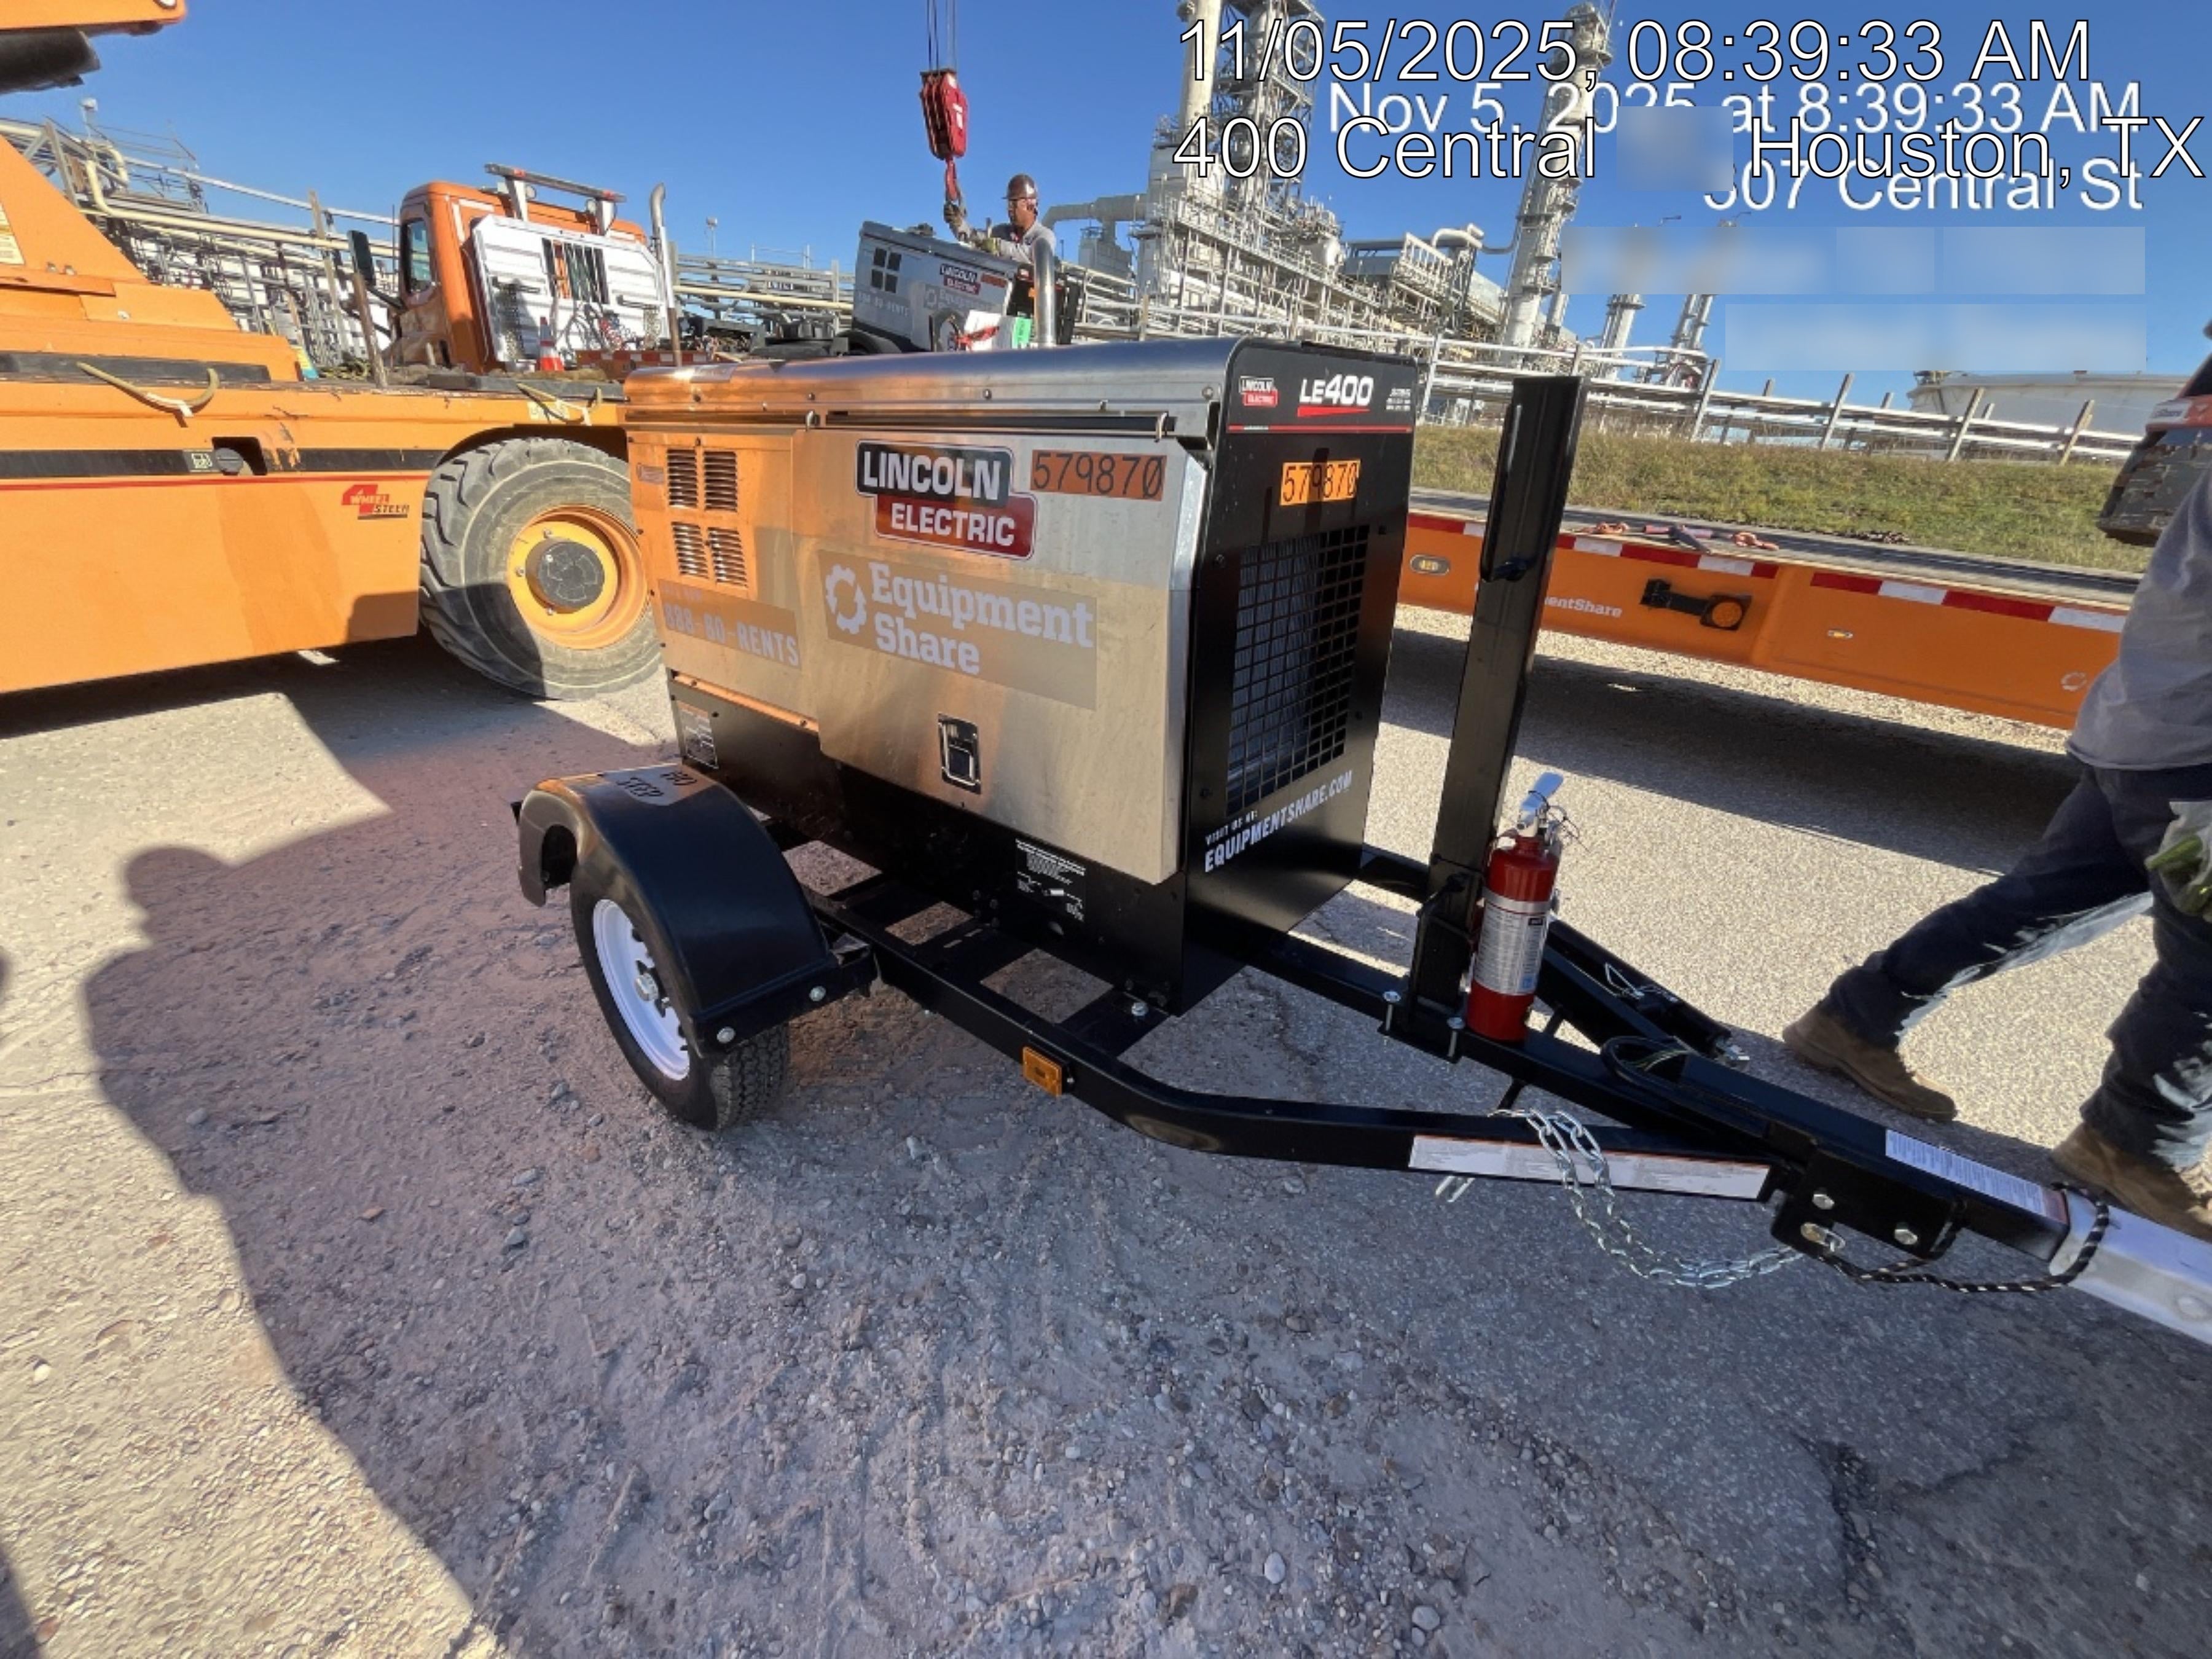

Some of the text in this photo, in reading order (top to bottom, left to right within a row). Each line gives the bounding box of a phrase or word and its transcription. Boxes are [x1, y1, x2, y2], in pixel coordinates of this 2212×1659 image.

[1299, 374, 1375, 406] LE400
[863, 451, 1001, 501] LINCOLN
[1033, 452, 1166, 498] 579870
[1283, 463, 1357, 502] 579870
[891, 502, 1014, 546] ELECTRIC
[868, 562, 1093, 648] Equipment
[874, 611, 979, 675] Share
[1205, 770, 1352, 873] EQUIPMENTSHARE.COM
